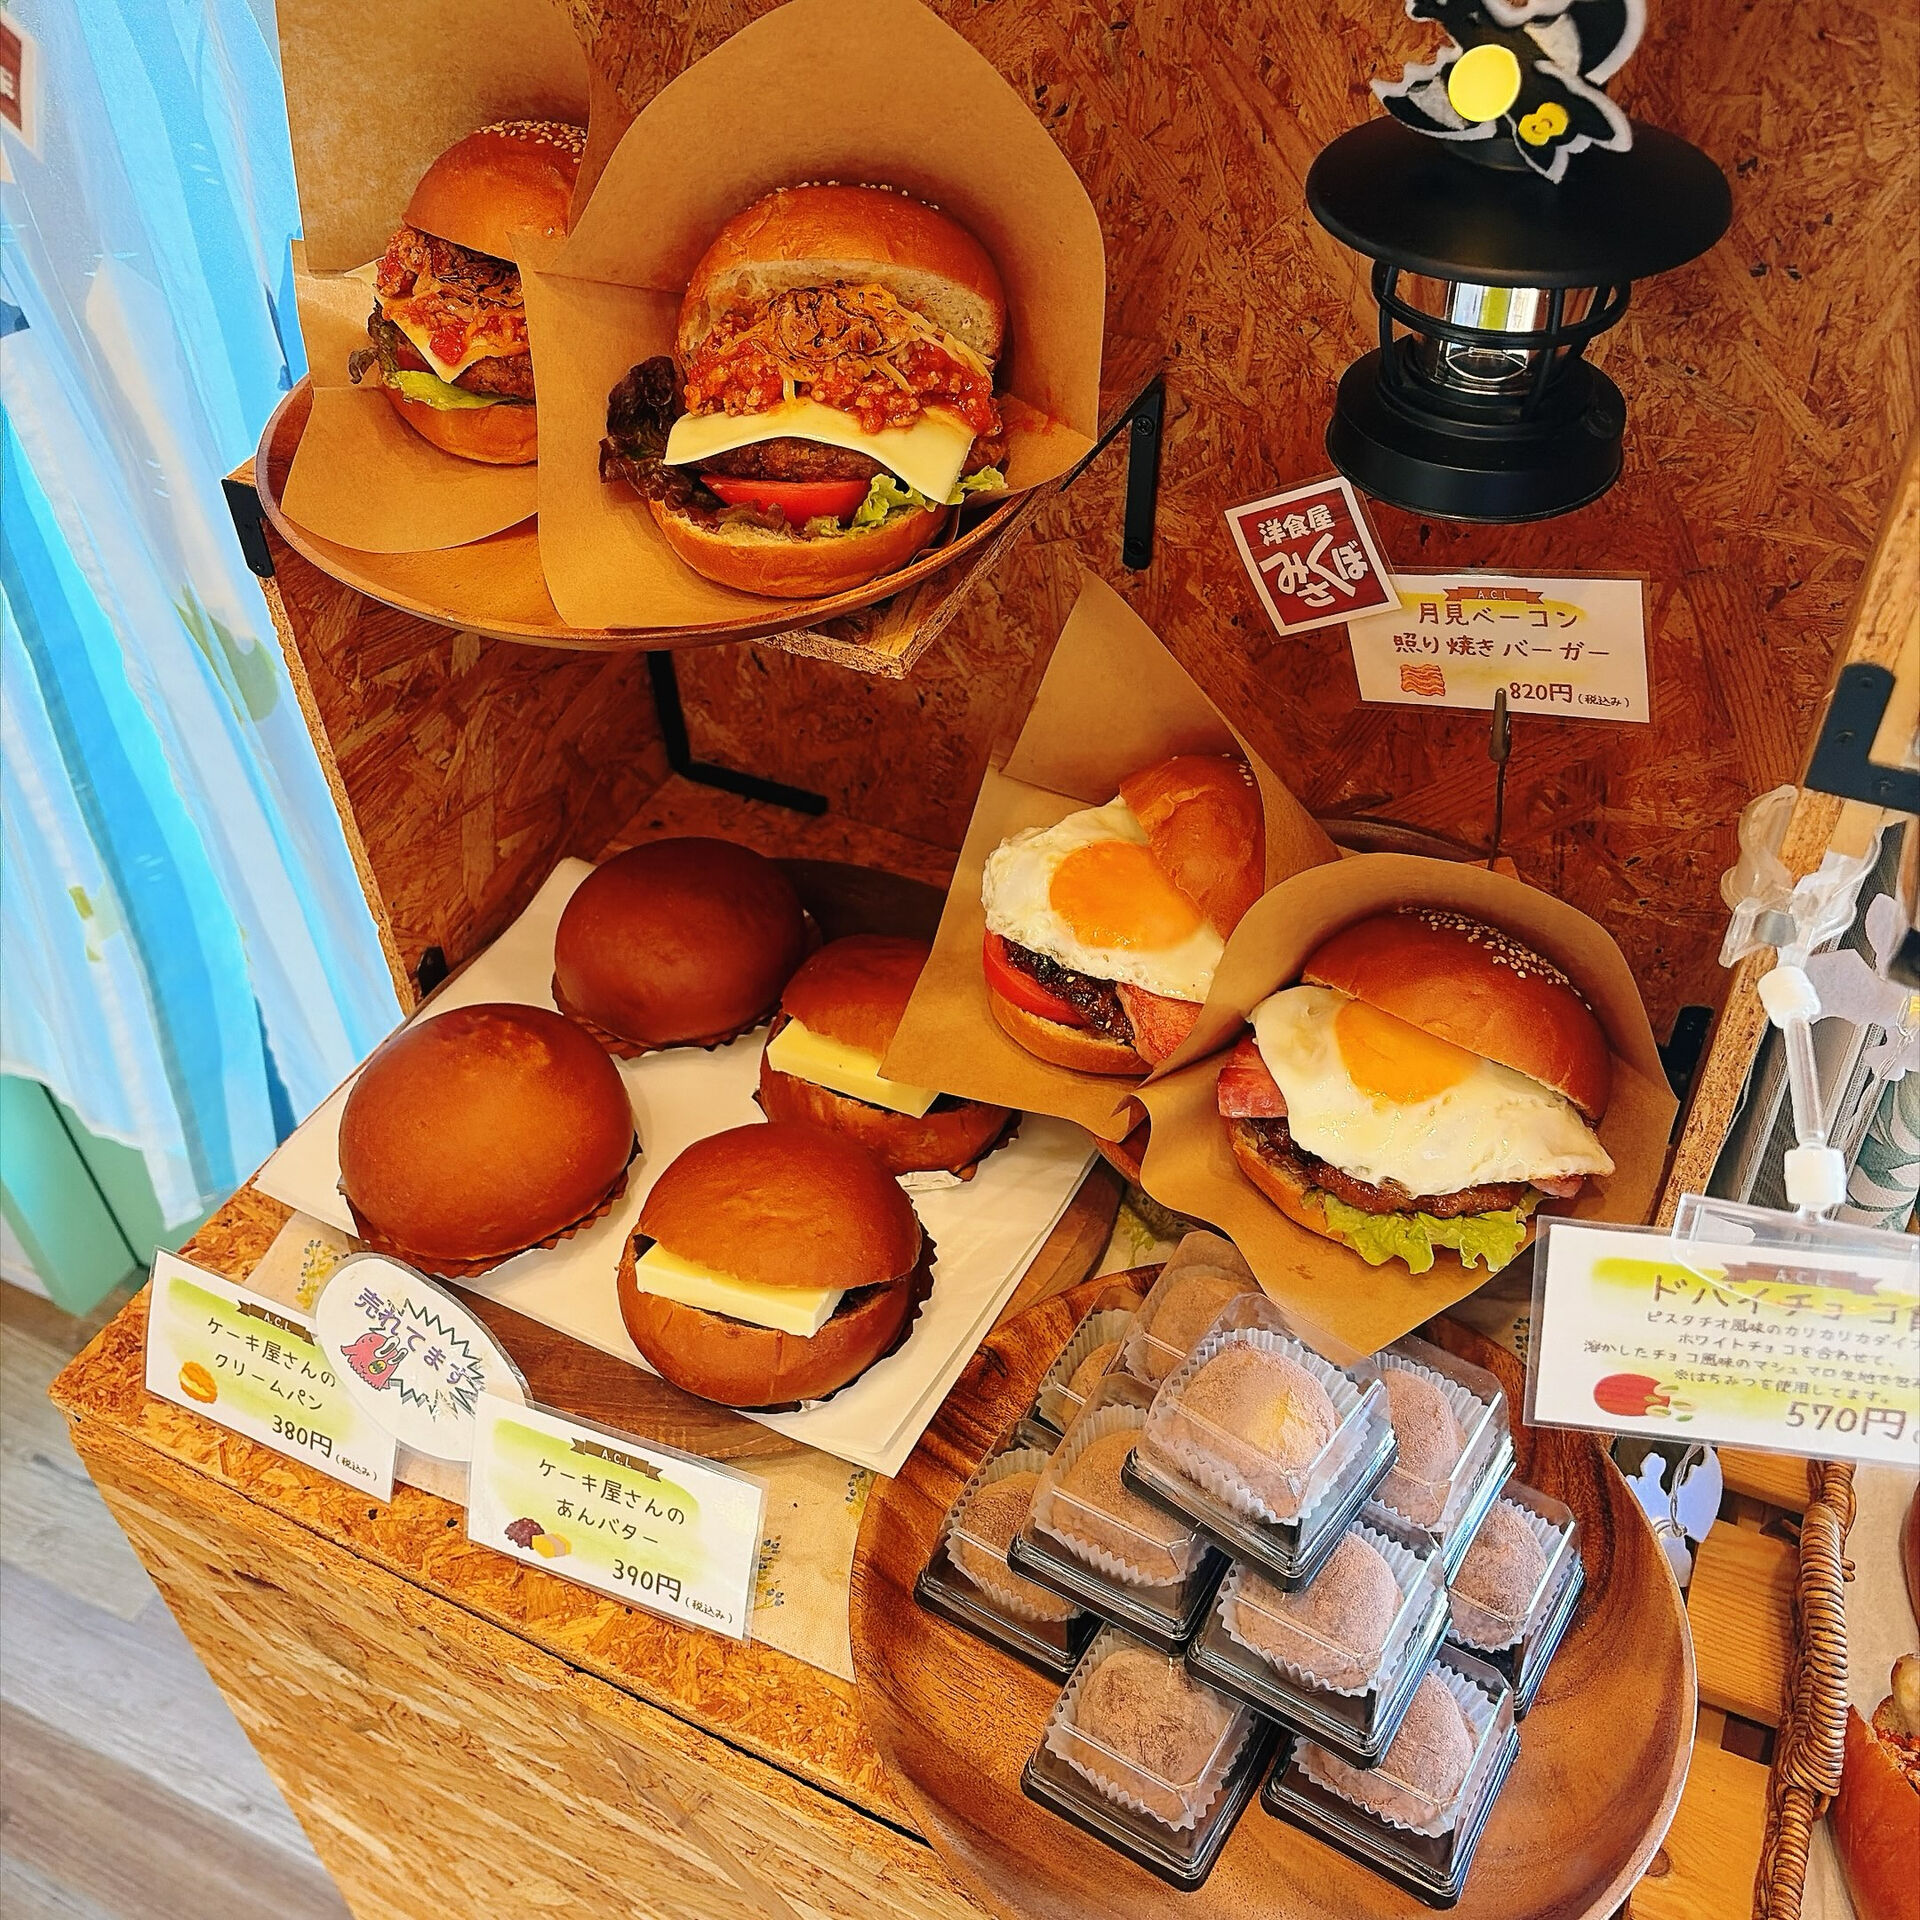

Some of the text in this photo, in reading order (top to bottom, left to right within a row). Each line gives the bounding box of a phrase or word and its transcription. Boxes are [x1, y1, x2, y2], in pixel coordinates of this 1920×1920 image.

[1257, 504, 1336, 546] 洋食屋
[1418, 602, 1578, 628] 月見ベーコン
[1393, 632, 1610, 661] 照り焼きバーガー
[1509, 682, 1573, 703] 820円
[208, 1318, 336, 1388] ケーキ屋さんの
[354, 1287, 466, 1384] 売れてます
[215, 1354, 323, 1411] クリームパン
[272, 1414, 332, 1458] 380円
[1786, 1401, 1907, 1441] 570円
[601, 1449, 632, 1468] A.C.L
[538, 1458, 685, 1525] ケーキ屋さんの
[556, 1499, 659, 1545] あんバター
[612, 1558, 682, 1602] 390円
